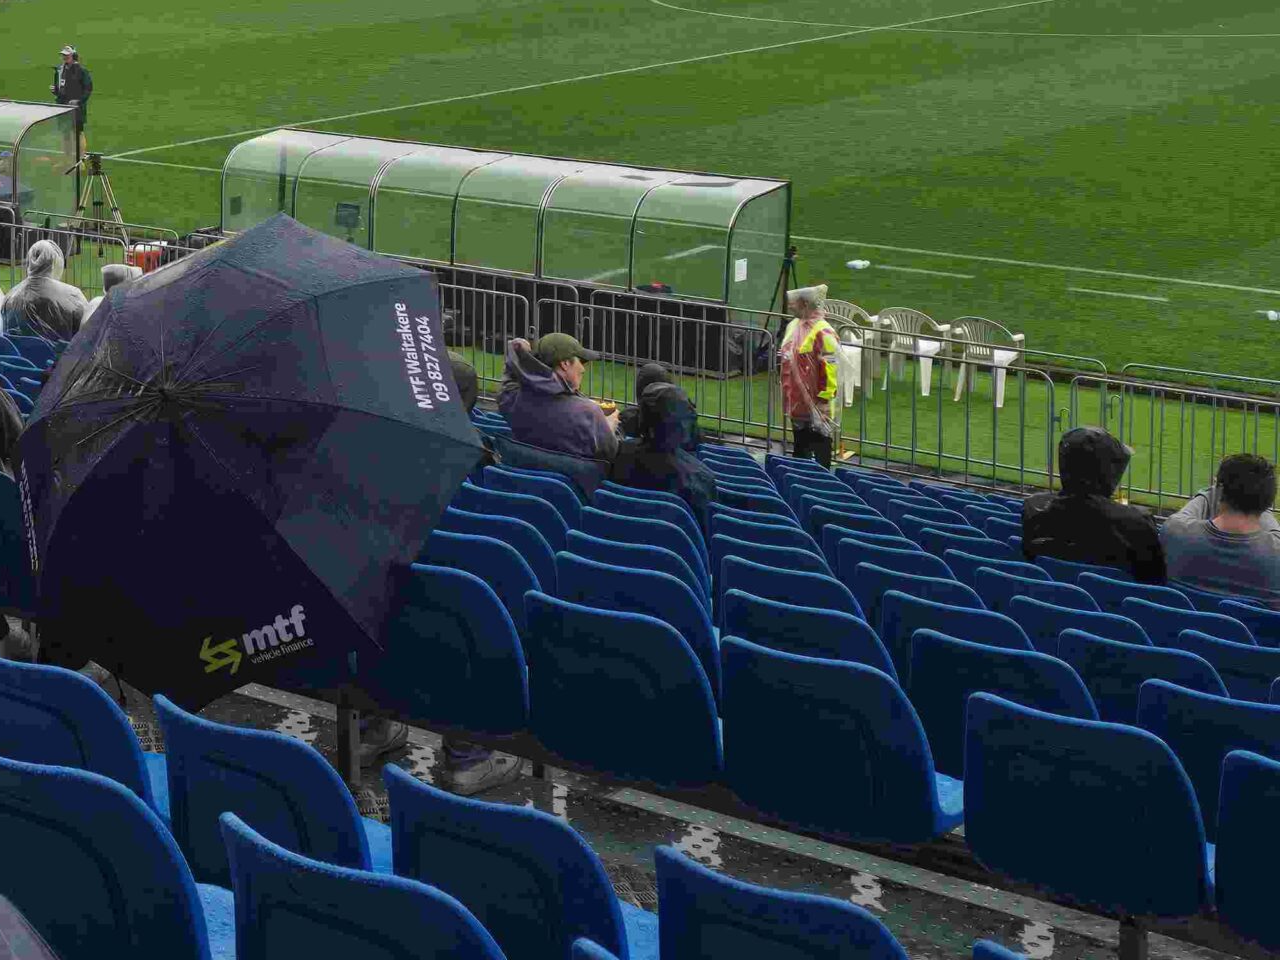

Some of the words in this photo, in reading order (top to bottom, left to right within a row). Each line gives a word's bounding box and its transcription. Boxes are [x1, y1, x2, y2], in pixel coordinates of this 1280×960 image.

[395, 302, 422, 375] Waitakere
[415, 315, 437, 352] 7404
[424, 352, 443, 381] 827
[410, 376, 434, 409] MTF
[432, 382, 450, 402] 09
[242, 604, 306, 655] mtf
[251, 649, 281, 664] vehicle
[280, 638, 315, 655] finance
